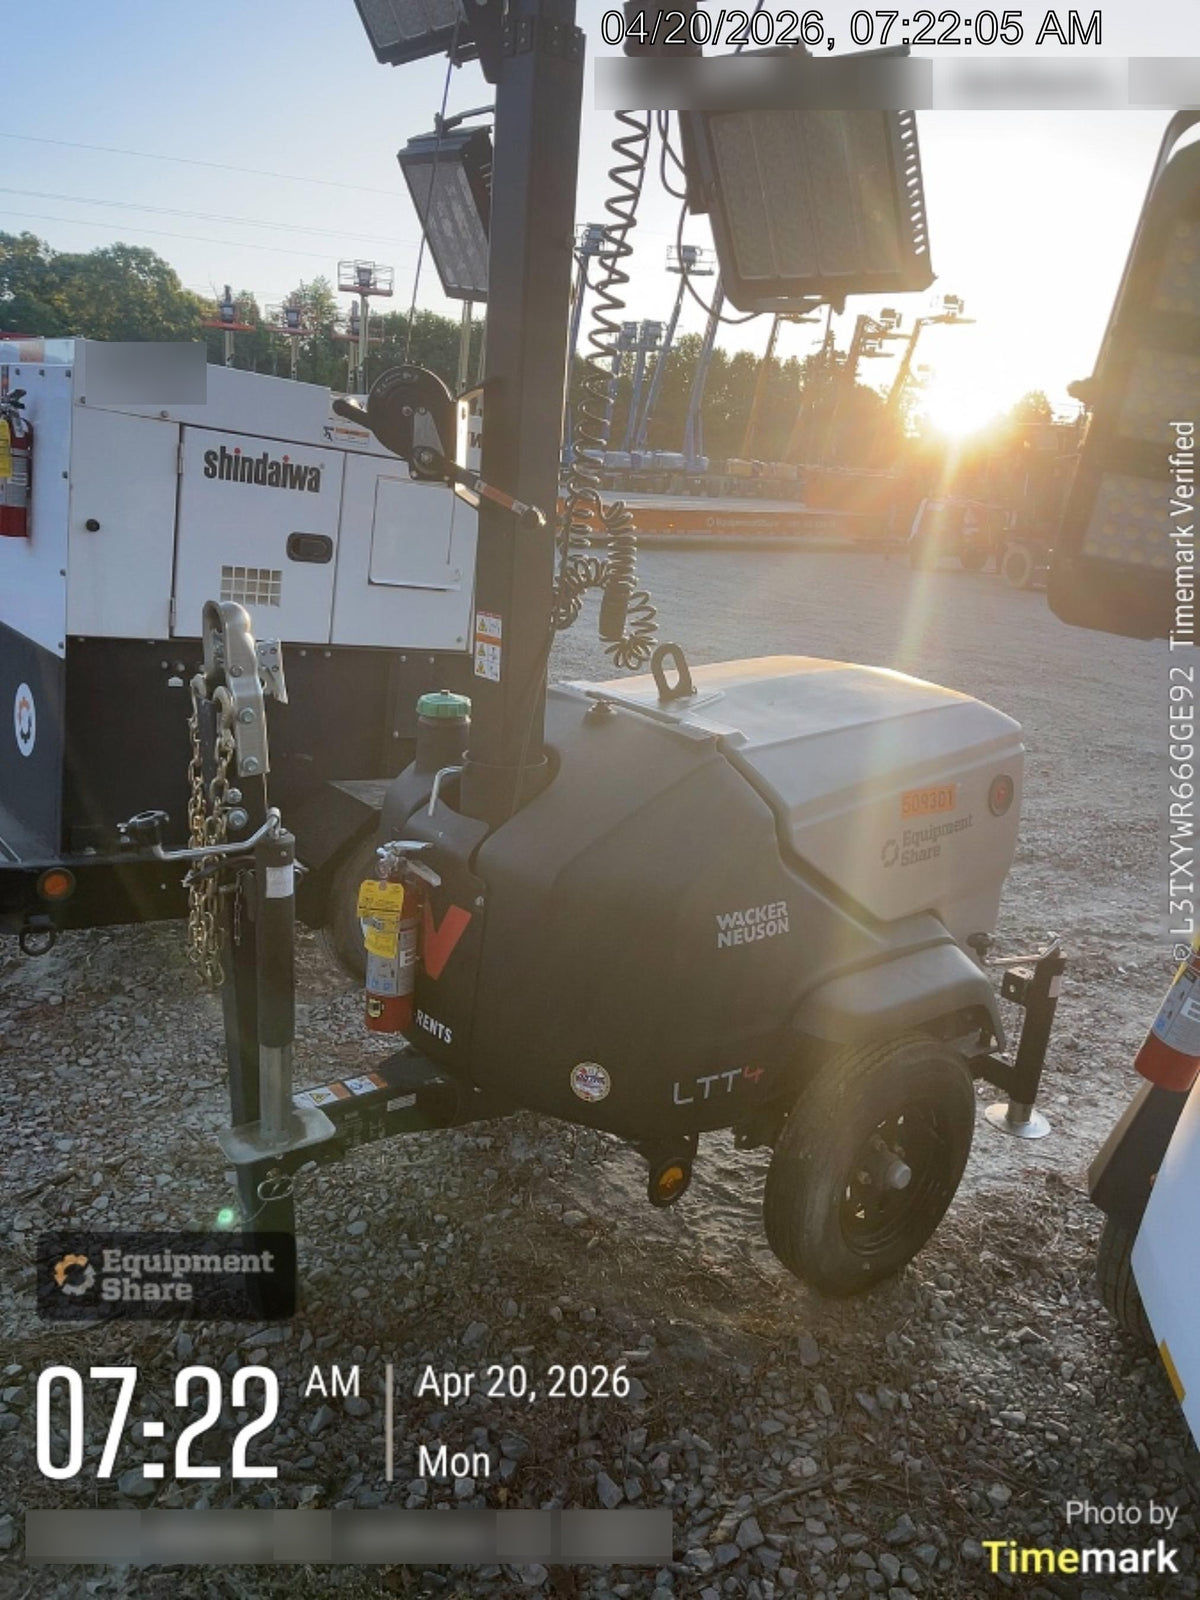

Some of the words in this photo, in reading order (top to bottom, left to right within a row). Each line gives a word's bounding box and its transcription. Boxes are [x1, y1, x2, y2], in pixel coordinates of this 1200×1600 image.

[203, 445, 321, 493] shindaiwa
[902, 813, 974, 849] Equipment
[900, 845, 942, 867] Share
[715, 900, 789, 931] WACKER
[717, 916, 790, 949] NEUSON
[415, 1008, 454, 1044] RENTS
